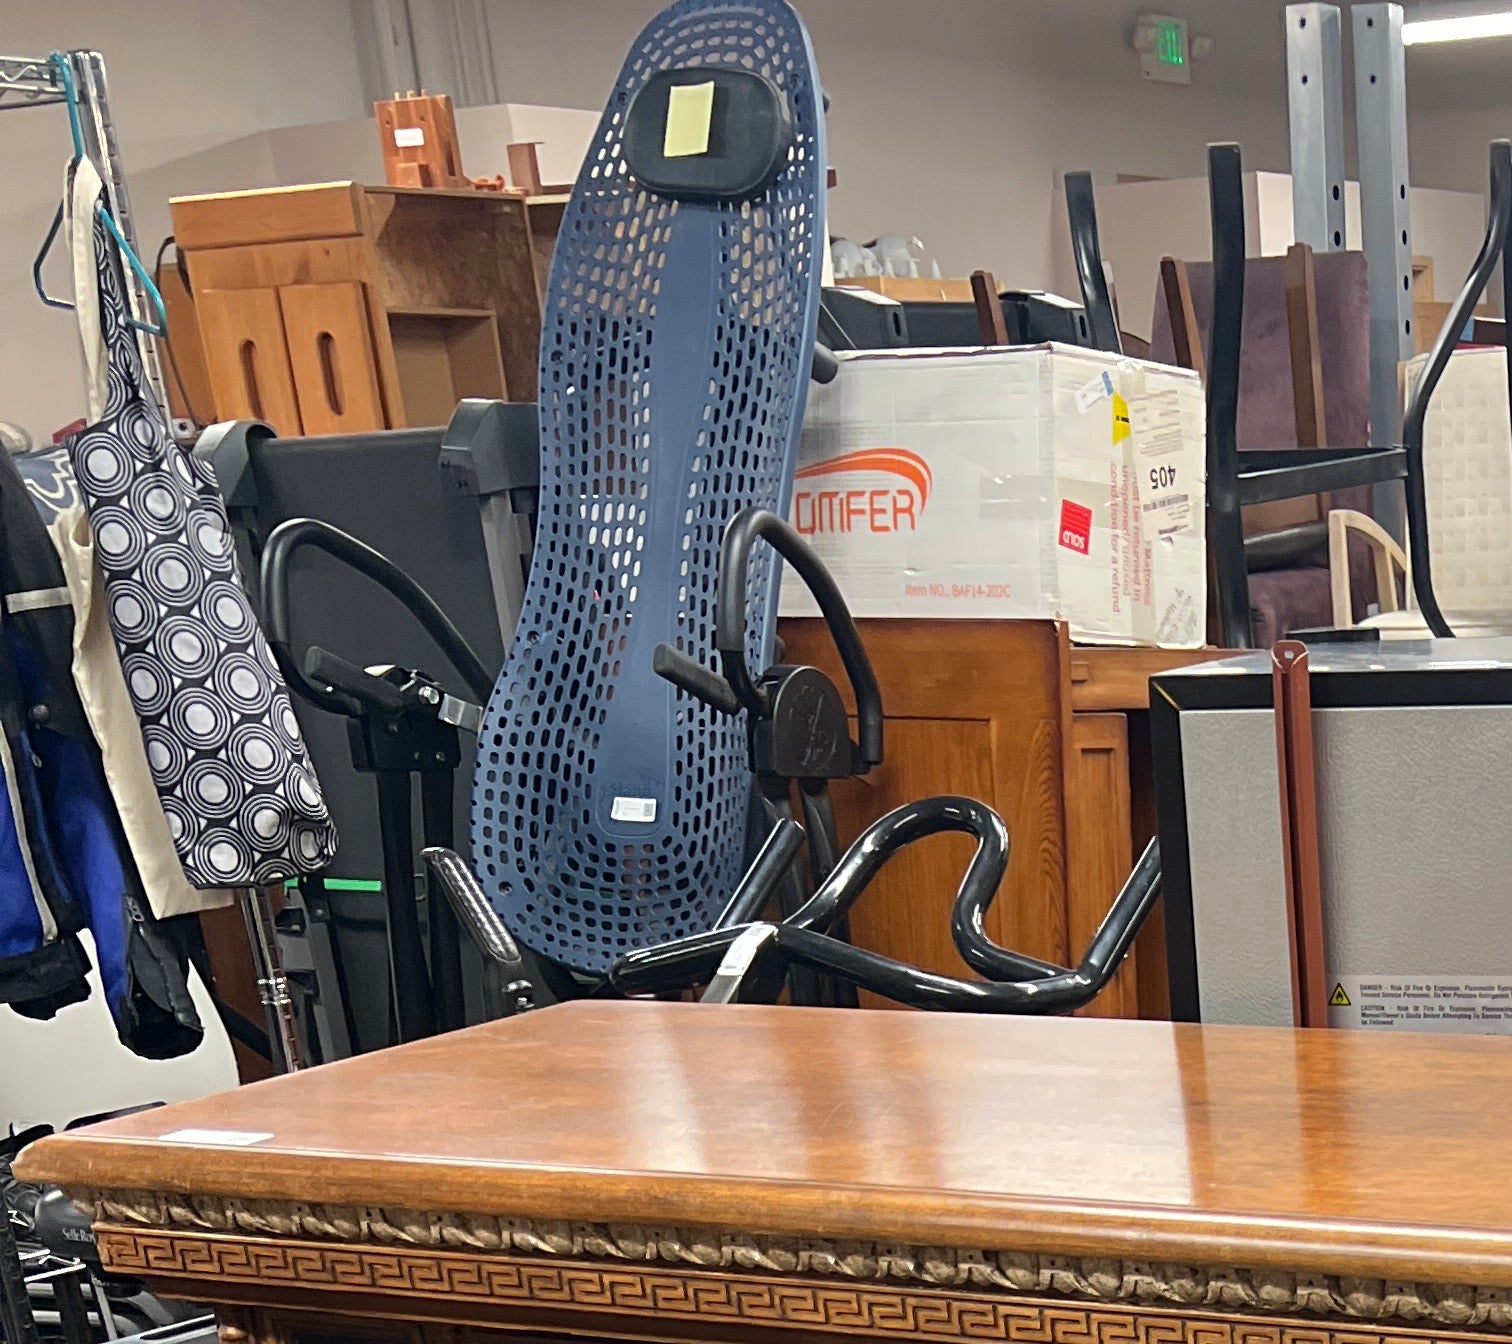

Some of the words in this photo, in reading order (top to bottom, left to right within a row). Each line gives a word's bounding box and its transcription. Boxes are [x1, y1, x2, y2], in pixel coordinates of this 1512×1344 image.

[1150, 465, 1176, 490] 405
[1063, 530, 1085, 550] SOLD
[1112, 568, 1121, 613] refund
